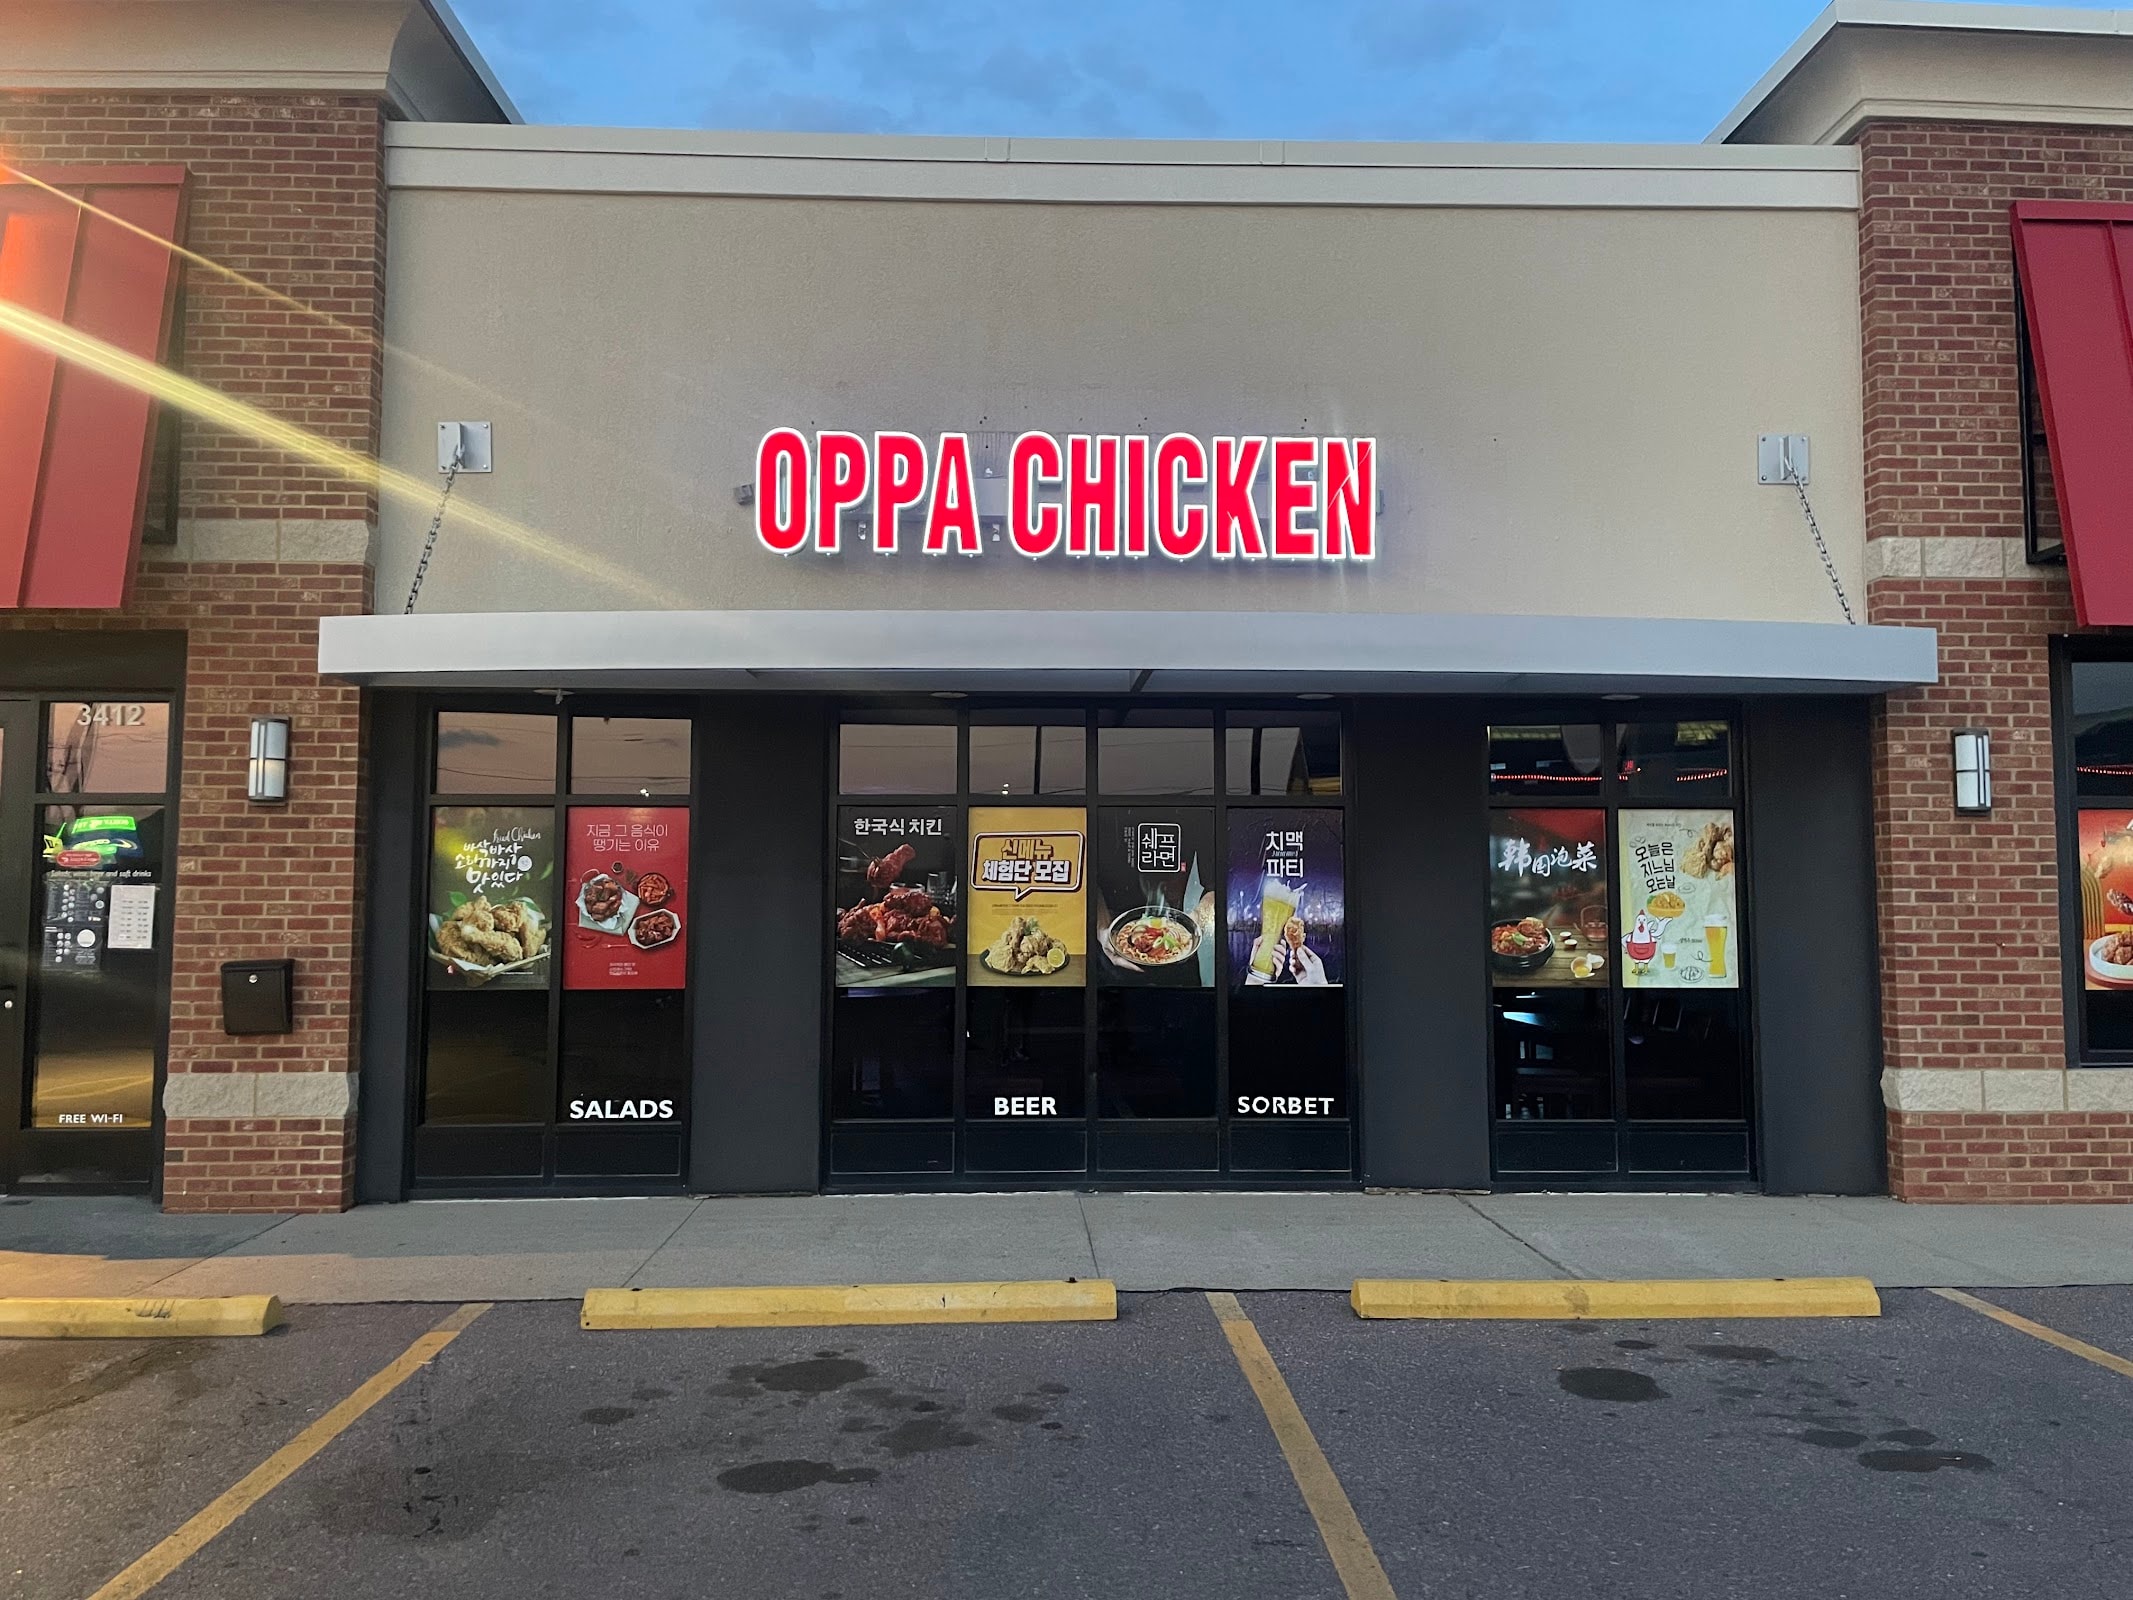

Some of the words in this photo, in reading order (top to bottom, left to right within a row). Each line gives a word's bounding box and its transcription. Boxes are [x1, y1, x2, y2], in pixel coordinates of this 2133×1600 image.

[755, 427, 983, 555] OPPA
[1008, 430, 1378, 562] CHICKEN
[77, 703, 144, 726] 3412
[586, 824, 611, 837] 지금
[615, 824, 628, 837] 그
[631, 823, 668, 838] 음식이
[854, 818, 905, 836] 한국식
[908, 818, 942, 836] 치킨
[593, 838, 631, 852] 땡기는
[634, 838, 660, 852] 이유
[1141, 827, 1177, 850] 쉐프
[1265, 831, 1304, 851] 치맥
[1001, 838, 1053, 860] 신메뉴
[1141, 850, 1176, 868] 라면
[1498, 837, 1598, 878] 韩国泡菜
[1635, 841, 1674, 863] 오늘은
[105, 870, 118, 878] and
[119, 870, 131, 879] soft
[131, 870, 152, 878] drinks
[982, 859, 1032, 883] 체험단
[1034, 859, 1071, 884] 모집
[1266, 858, 1304, 878] 파티
[466, 867, 524, 893] 맛있다
[1646, 874, 1676, 894] 오는날
[569, 1099, 674, 1119] SALADS
[994, 1097, 1057, 1116] BEER
[1237, 1096, 1335, 1115] SORBET
[59, 1114, 86, 1124] FREE
[91, 1113, 123, 1124] WI-FI
